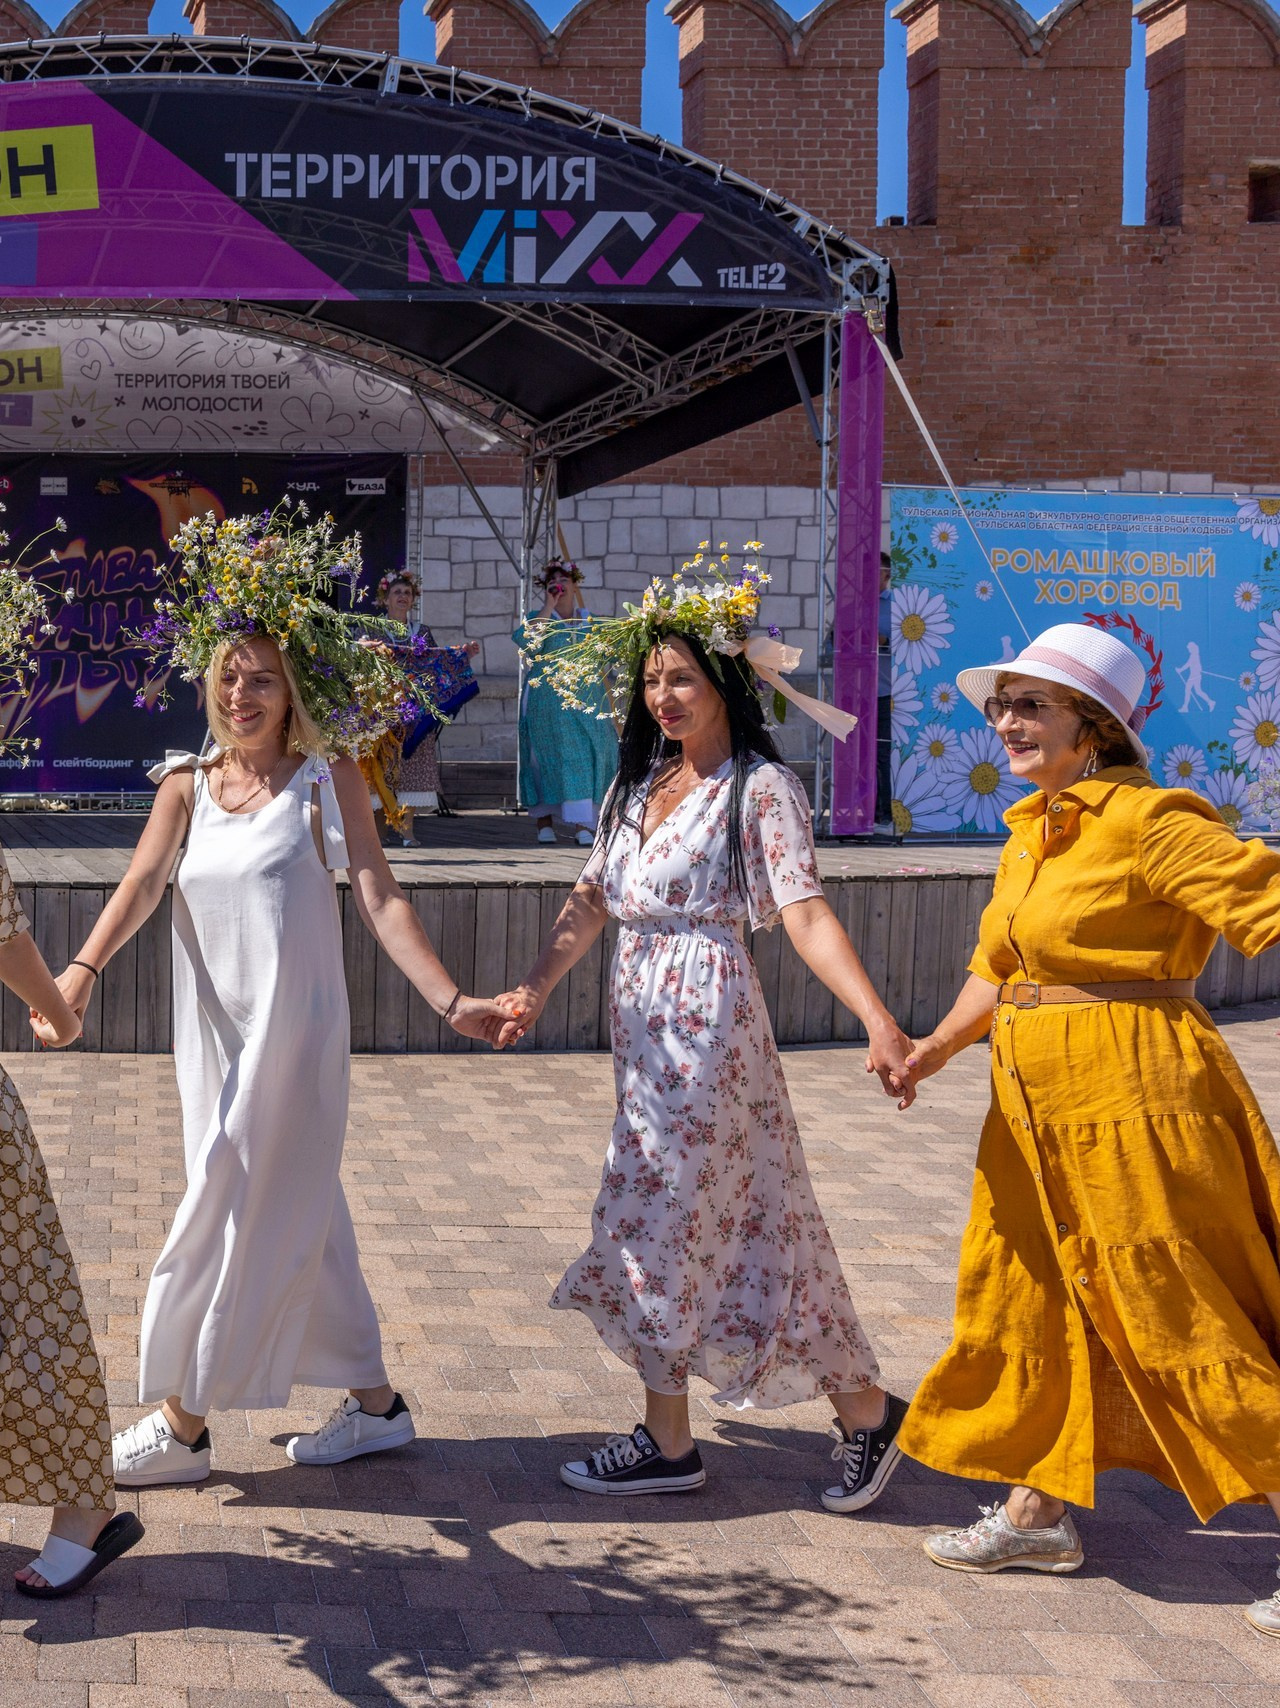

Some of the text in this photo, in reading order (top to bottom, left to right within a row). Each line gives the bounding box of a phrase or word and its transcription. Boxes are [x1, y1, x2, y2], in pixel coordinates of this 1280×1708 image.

[224, 152, 597, 201] ТЕРРИТОРИЯ
[717, 262, 786, 291] TELE2
[114, 371, 290, 389] ТЕРРИТОРИЯ ТВОЕЙ
[142, 396, 263, 414] МОЛОДОСТИ
[357, 482, 385, 491] БАЗА
[903, 507, 950, 517] ТУЛЬСКАЯ
[951, 509, 1026, 519] РЕИОНАЛЬНАЯ
[1164, 514, 1236, 525] ОБЩЕСТВЕННАЯ
[1028, 521, 1084, 531] ОБЛАСТНАЯ
[1086, 522, 1141, 533] ФЕДЕРАЦИЯ
[1142, 523, 1189, 534] СЕВЕРНОЙ
[991, 547, 1216, 578] РОМАШКОВЫЙ
[1034, 579, 1181, 610] ХОРОВОД
[53, 756, 134, 769] скейтбординг
